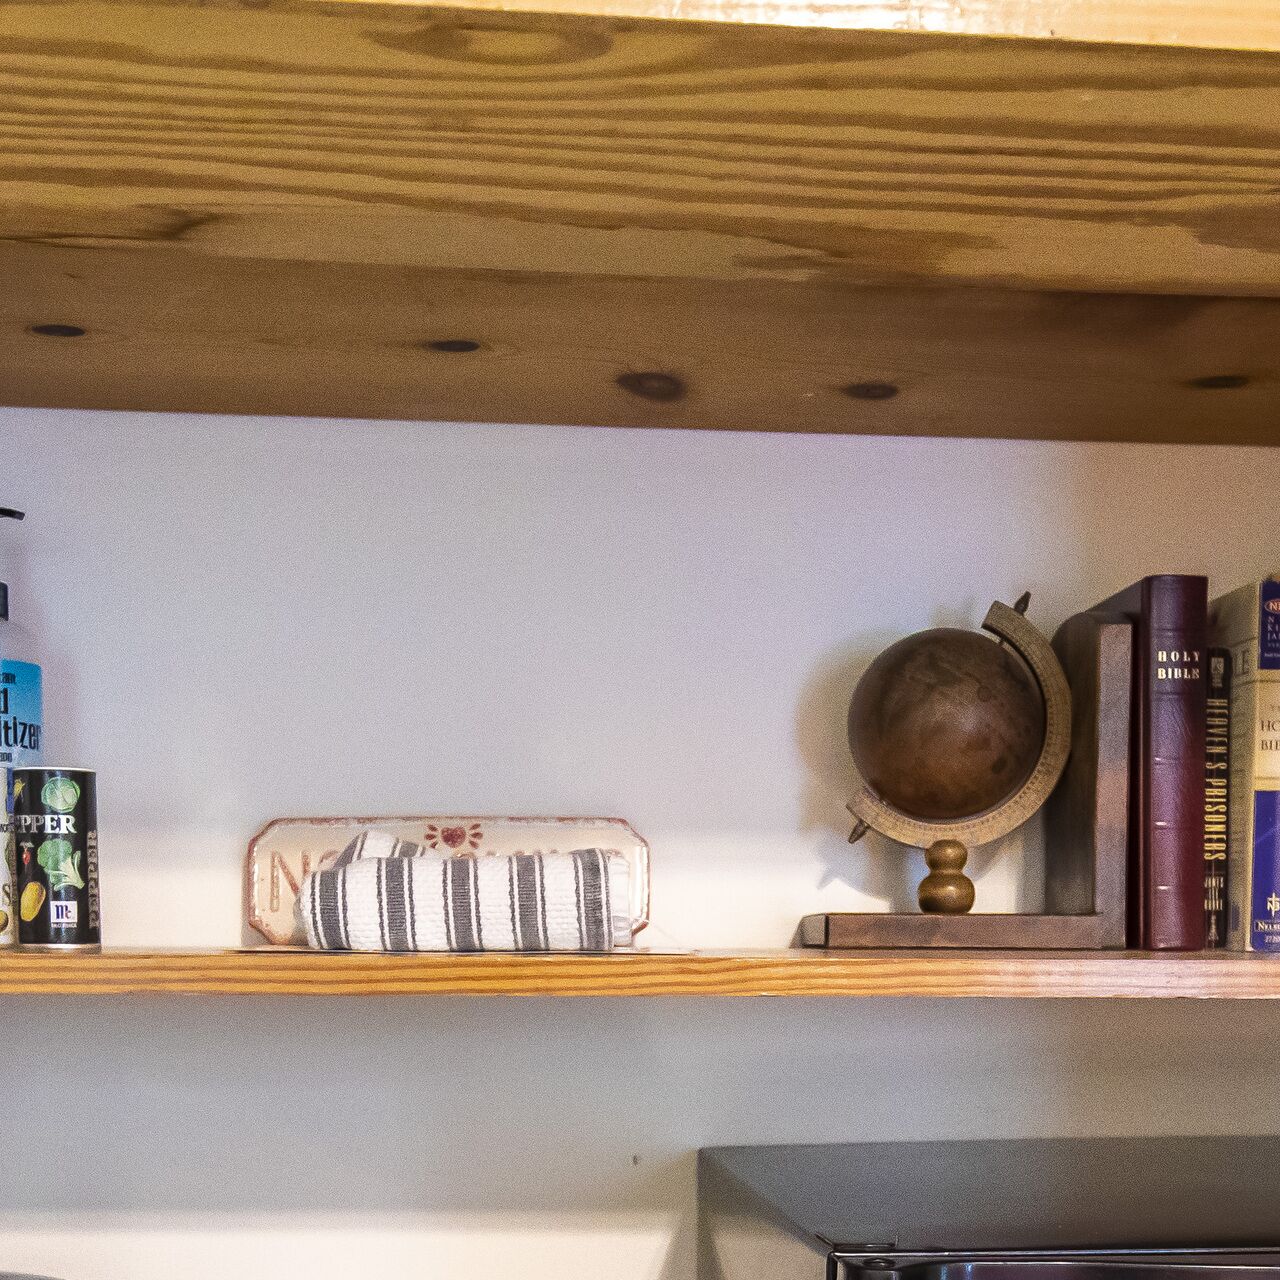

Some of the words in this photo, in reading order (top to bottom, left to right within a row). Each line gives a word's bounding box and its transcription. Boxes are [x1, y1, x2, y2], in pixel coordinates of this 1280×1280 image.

[1157, 651, 1200, 662] HOLY
[1157, 668, 1200, 679] BIBLE
[1205, 698, 1229, 770] HEAVEN'S
[1204, 779, 1228, 860] PRISONERS
